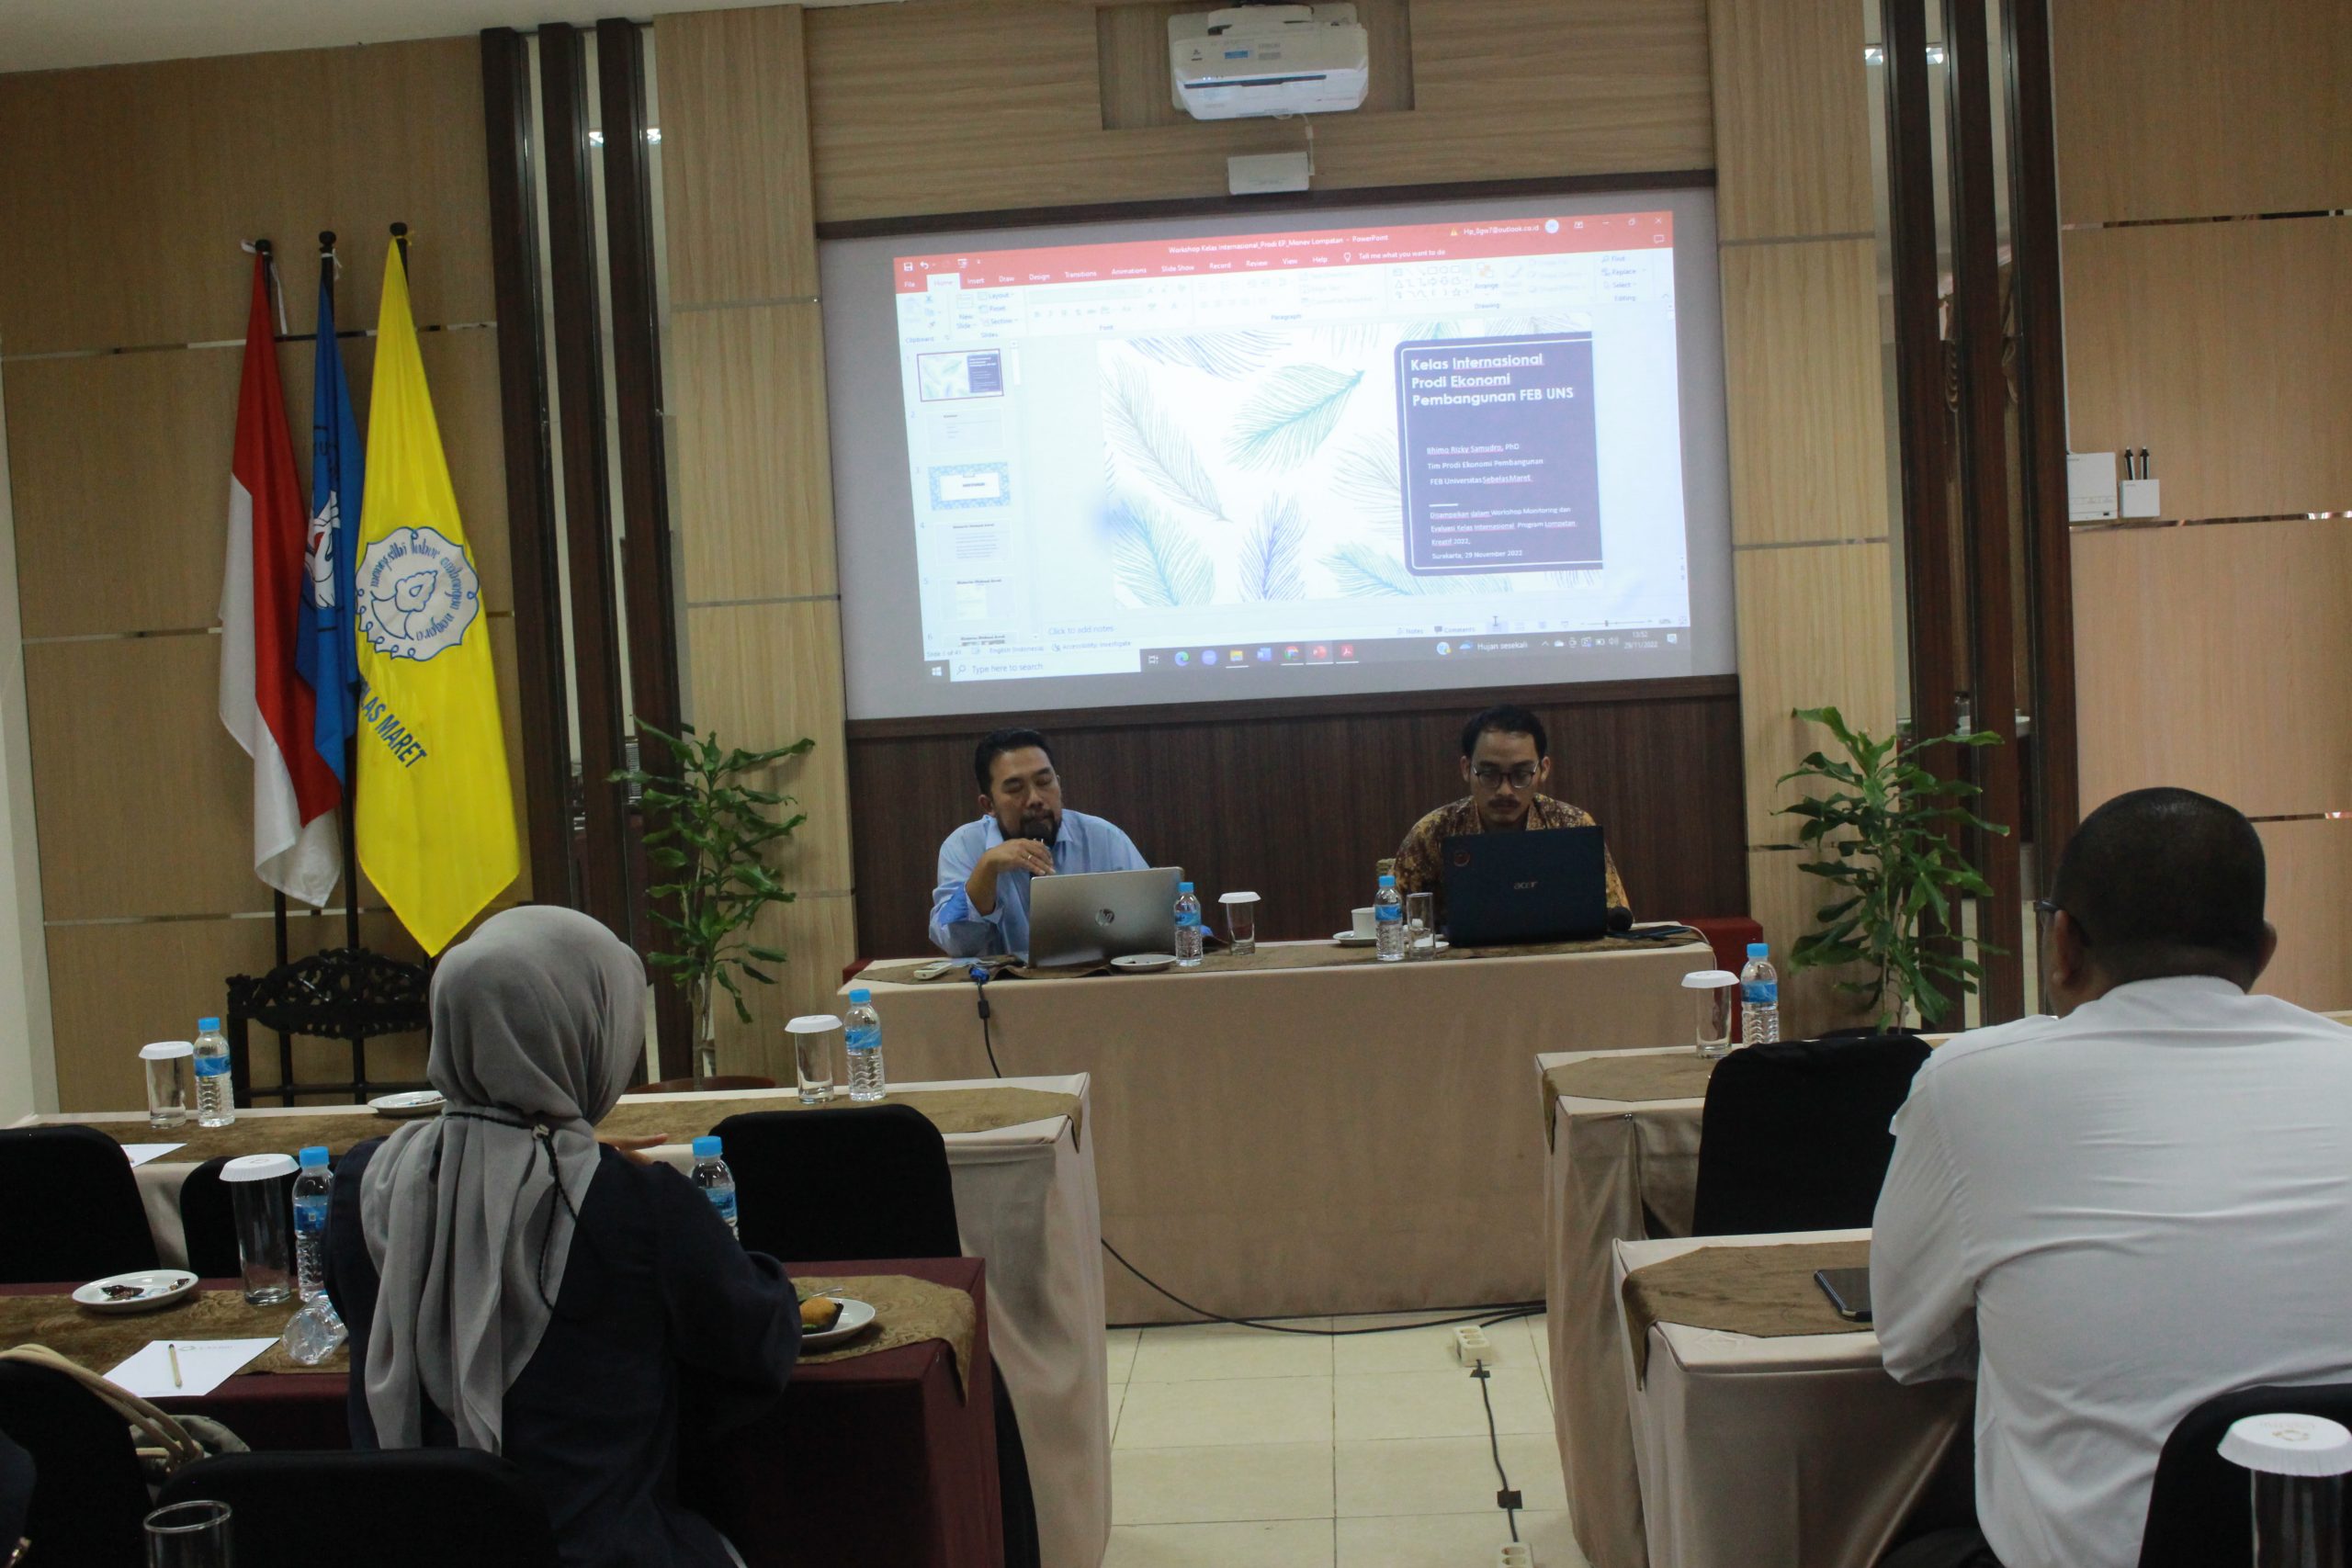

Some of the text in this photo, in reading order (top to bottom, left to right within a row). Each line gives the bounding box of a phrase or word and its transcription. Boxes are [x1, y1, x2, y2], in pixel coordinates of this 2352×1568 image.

[1169, 245, 1200, 254] Workshop
[1311, 236, 1343, 246] Lompatan
[1352, 234, 1388, 243] PowerPoint
[1313, 255, 1328, 264] Help
[1359, 252, 1369, 260] Tell
[1065, 270, 1097, 278] Transitions
[1111, 266, 1147, 276] Animations
[1029, 273, 1050, 281] Design
[1410, 353, 1544, 371] Kelas Internasional
[1411, 373, 1510, 389] Prodi Ekonomi
[1412, 387, 1573, 406] Pembangunan FEB UNS
[1505, 443, 1520, 451] PhD
[1428, 458, 1544, 470] Tim Prodi Ekonomi Pembangunan
[1444, 477, 1483, 485] Universitas
[1483, 476, 1509, 484] Sebelas
[1509, 474, 1532, 482] Maret
[1471, 510, 1490, 518] dalam
[1456, 524, 1473, 532] Kelas
[1474, 523, 1515, 531] Internasional
[1517, 521, 1544, 530] Program
[1431, 552, 1464, 560] Surakarta,
[1474, 550, 1506, 558] November
[1048, 626, 1066, 636] Click
[1093, 625, 1114, 633] notes
[1477, 641, 1528, 651] Hujan sesekali
[972, 665, 989, 674] Type
[990, 664, 1008, 672] here
[1019, 662, 1044, 671] search
[375, 714, 428, 768] MARET
[1513, 880, 1539, 890] acer
